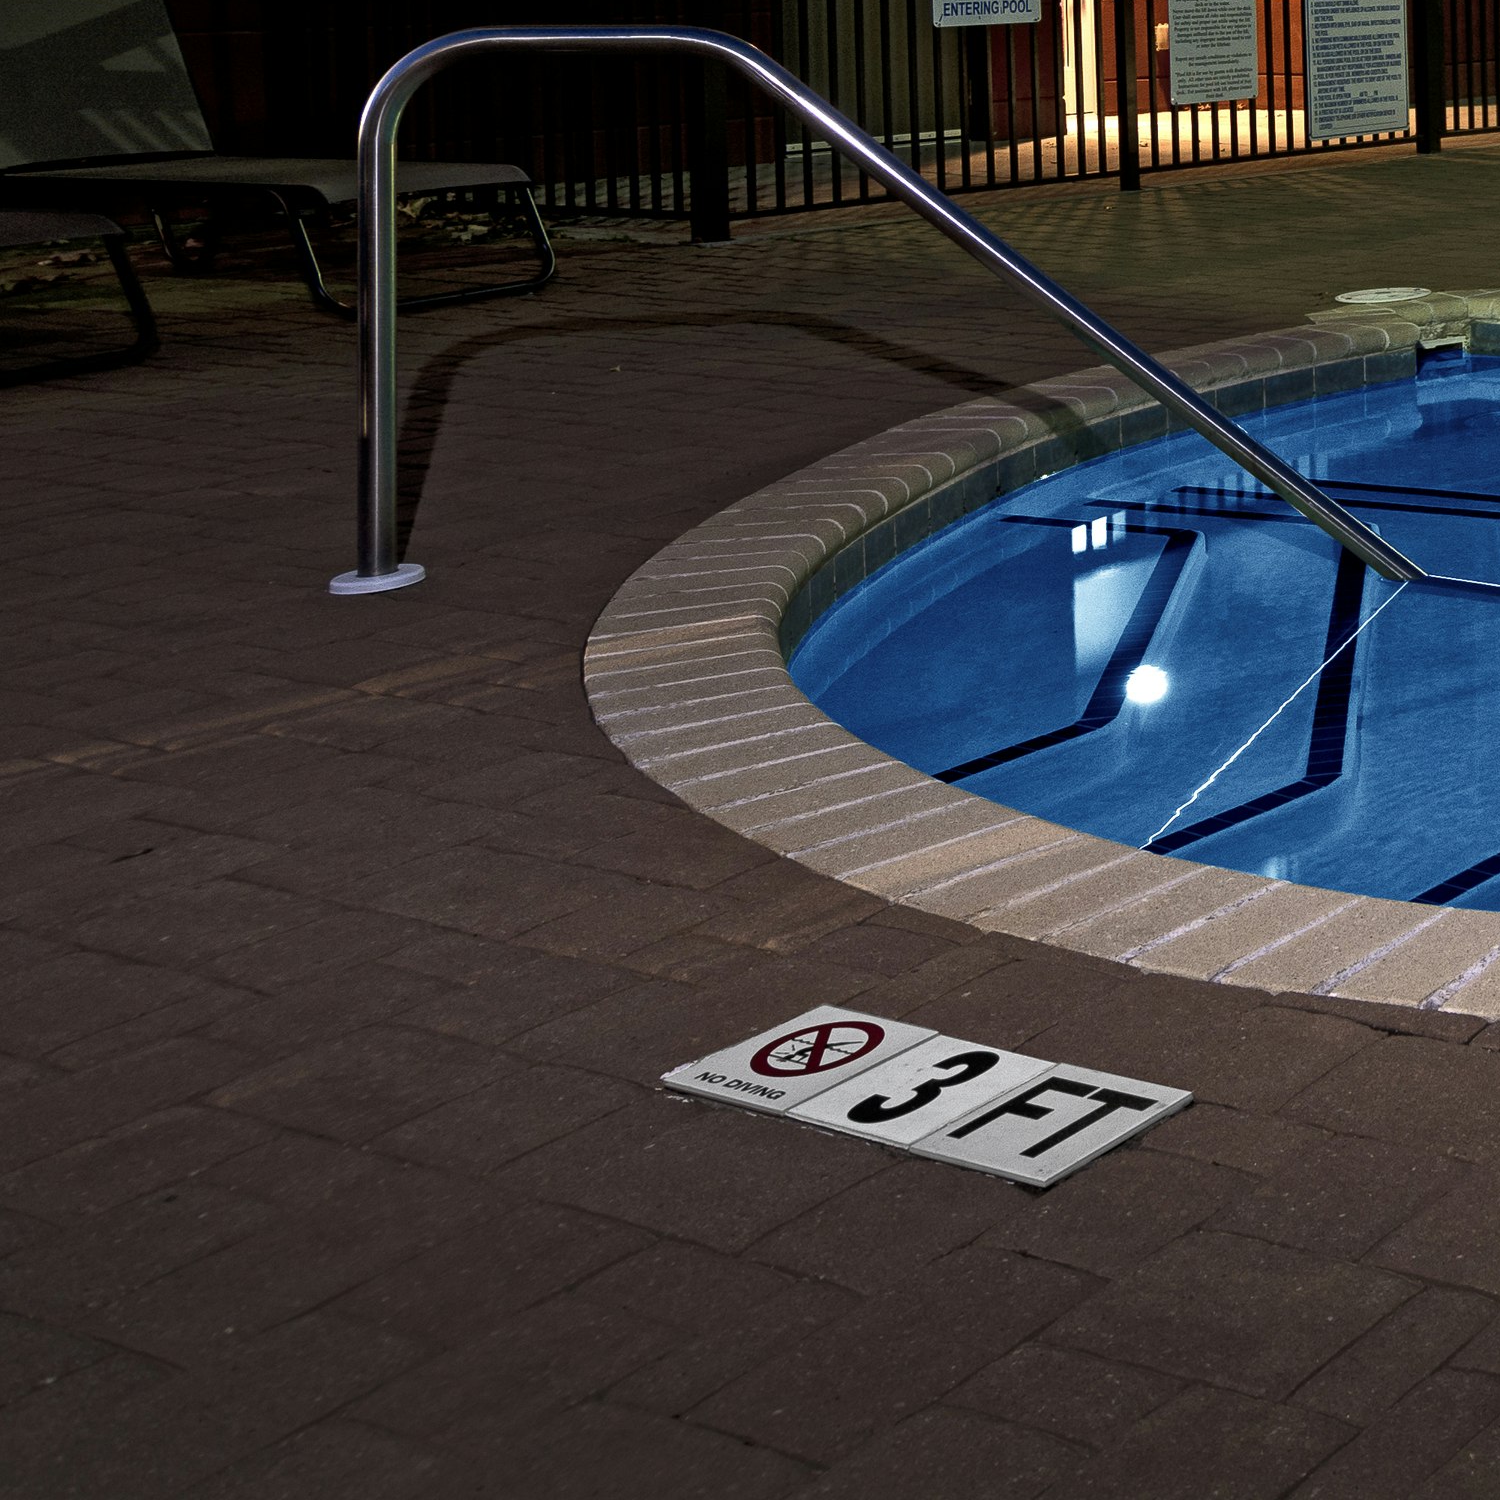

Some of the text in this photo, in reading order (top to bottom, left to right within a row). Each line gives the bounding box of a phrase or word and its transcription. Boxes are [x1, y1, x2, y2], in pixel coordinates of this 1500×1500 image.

[944, 0, 1032, 16] ENTERING POOL
[694, 1072, 786, 1100] NO DIVING
[847, 1050, 1159, 1158] 3 FT
